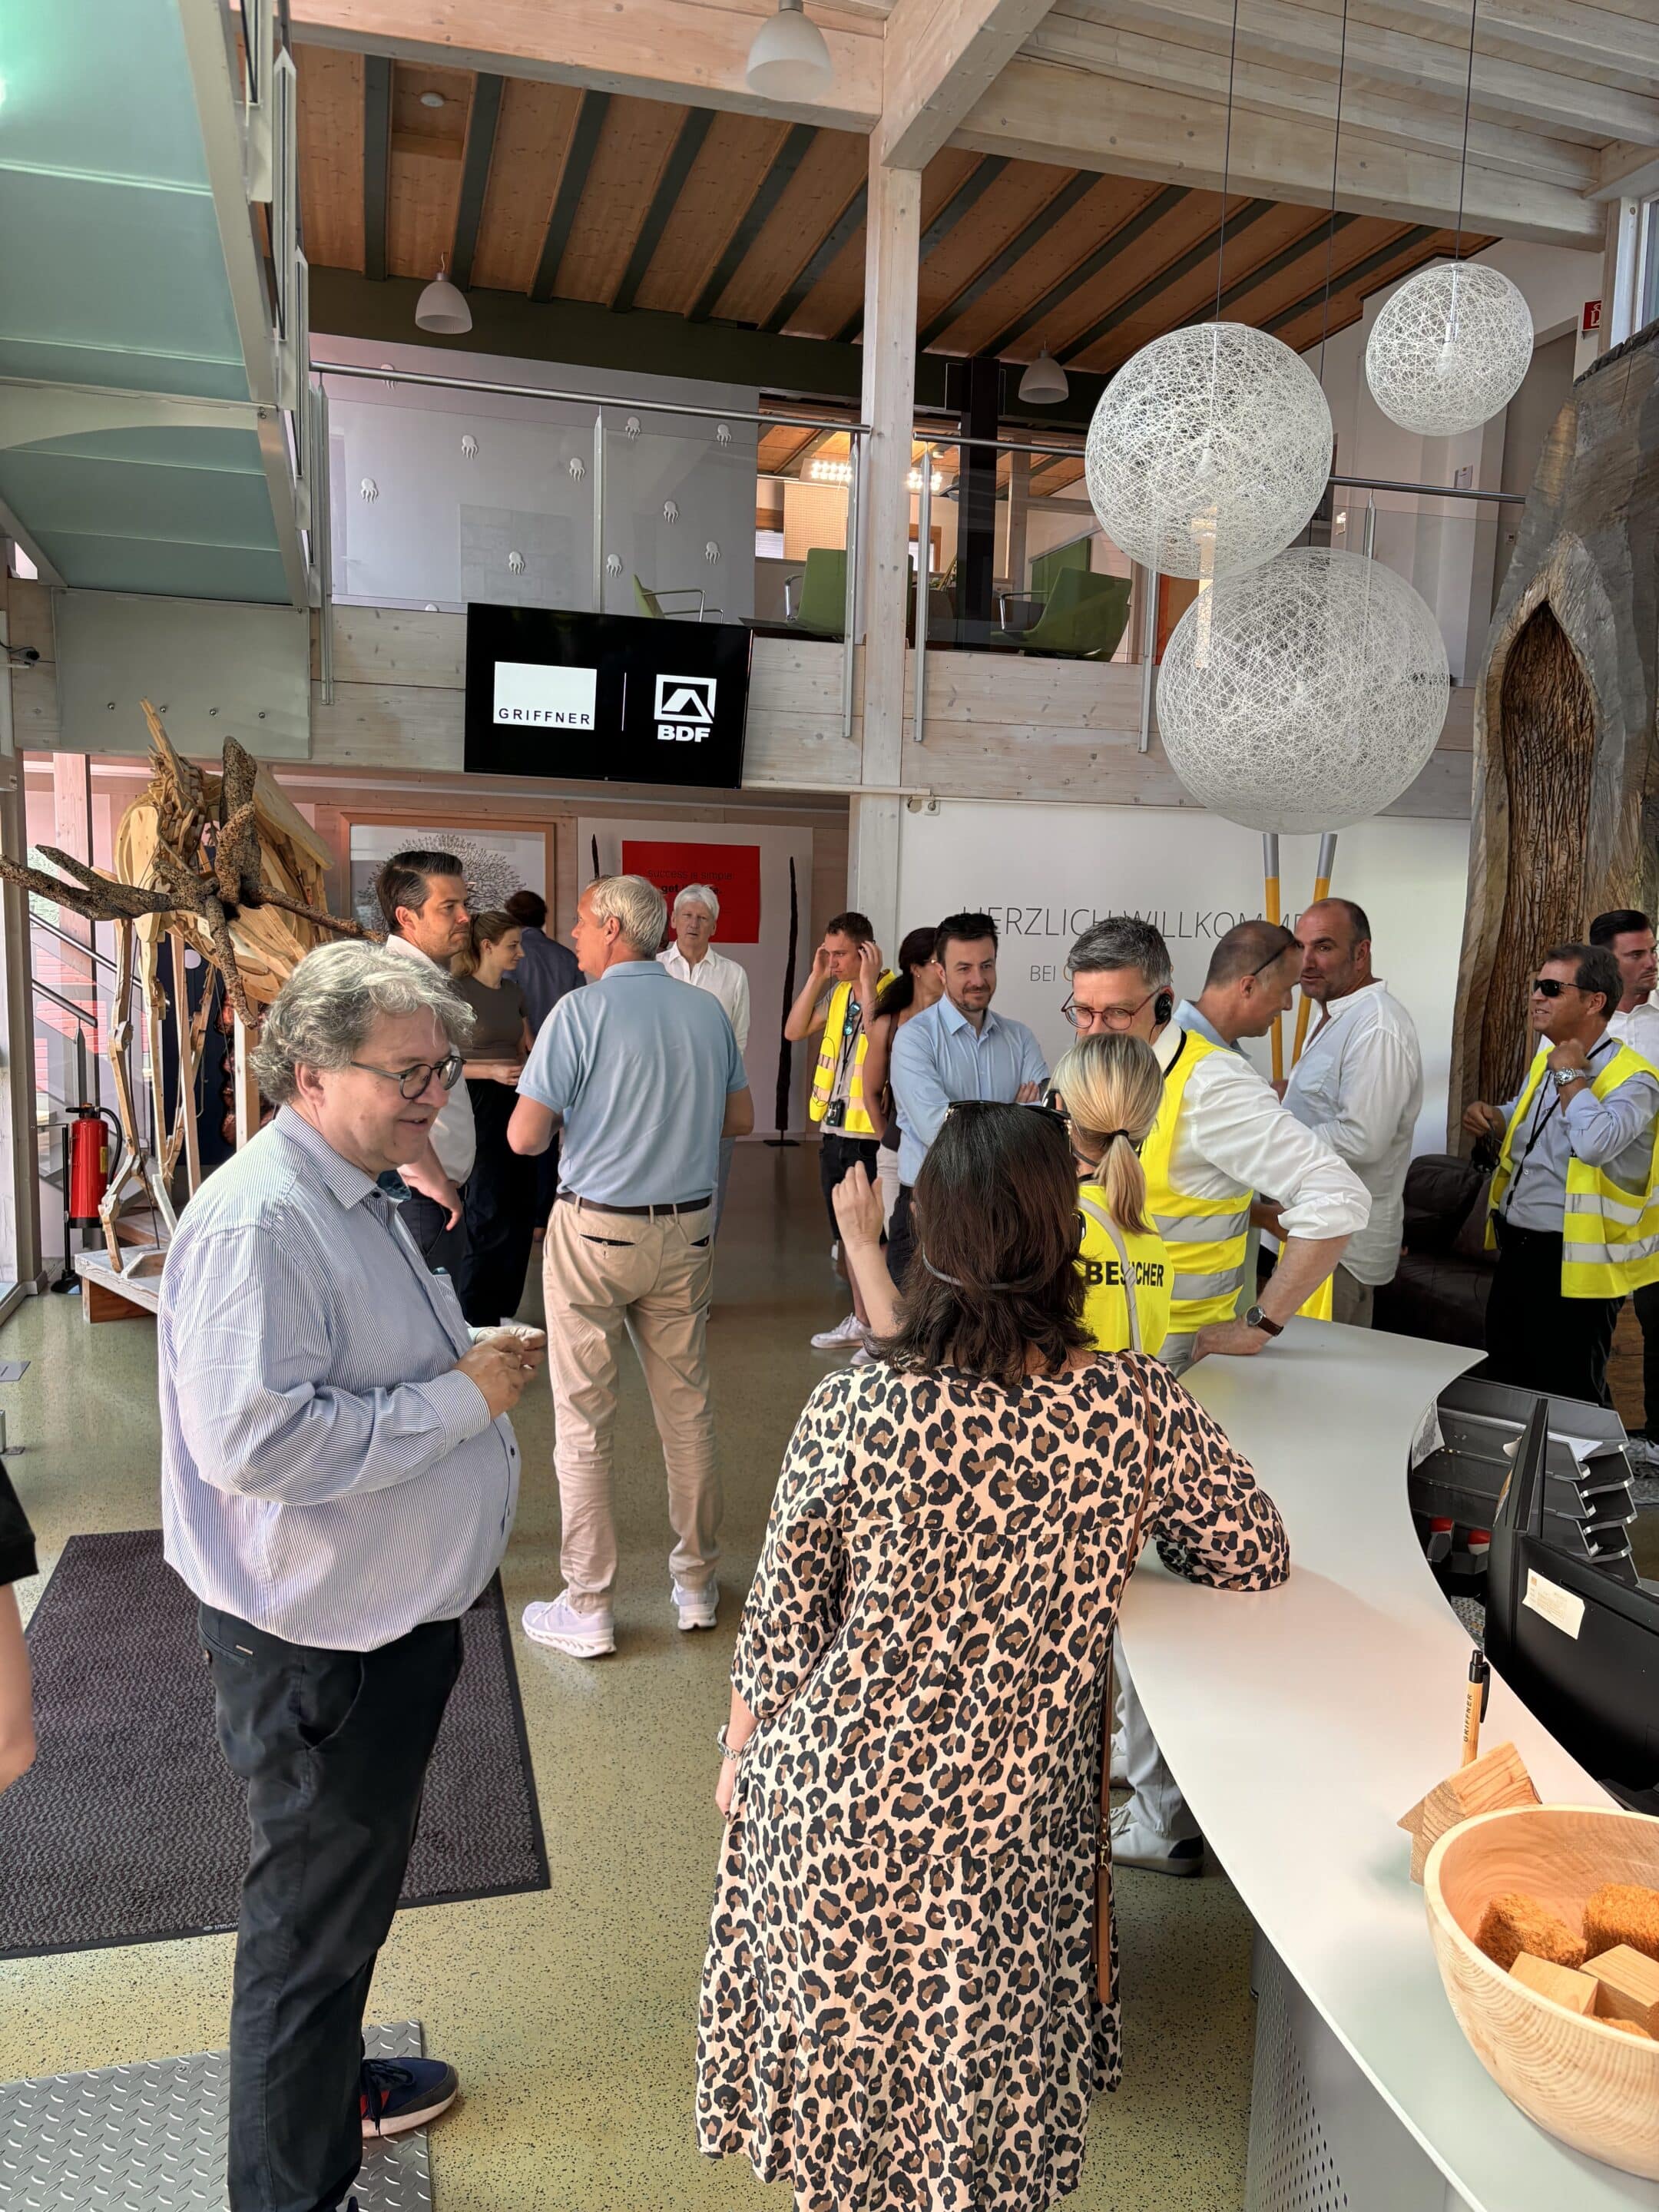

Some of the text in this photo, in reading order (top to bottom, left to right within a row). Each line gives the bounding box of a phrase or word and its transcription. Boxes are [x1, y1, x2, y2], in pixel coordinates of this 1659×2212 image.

[498, 707, 590, 725] GRIFFNER
[657, 724, 711, 743] BDF
[661, 883, 679, 895] get
[1030, 965, 1056, 982] BEI
[1085, 1260, 1164, 1287] BECHER
[1463, 1694, 1473, 1743] GRIFFNER
